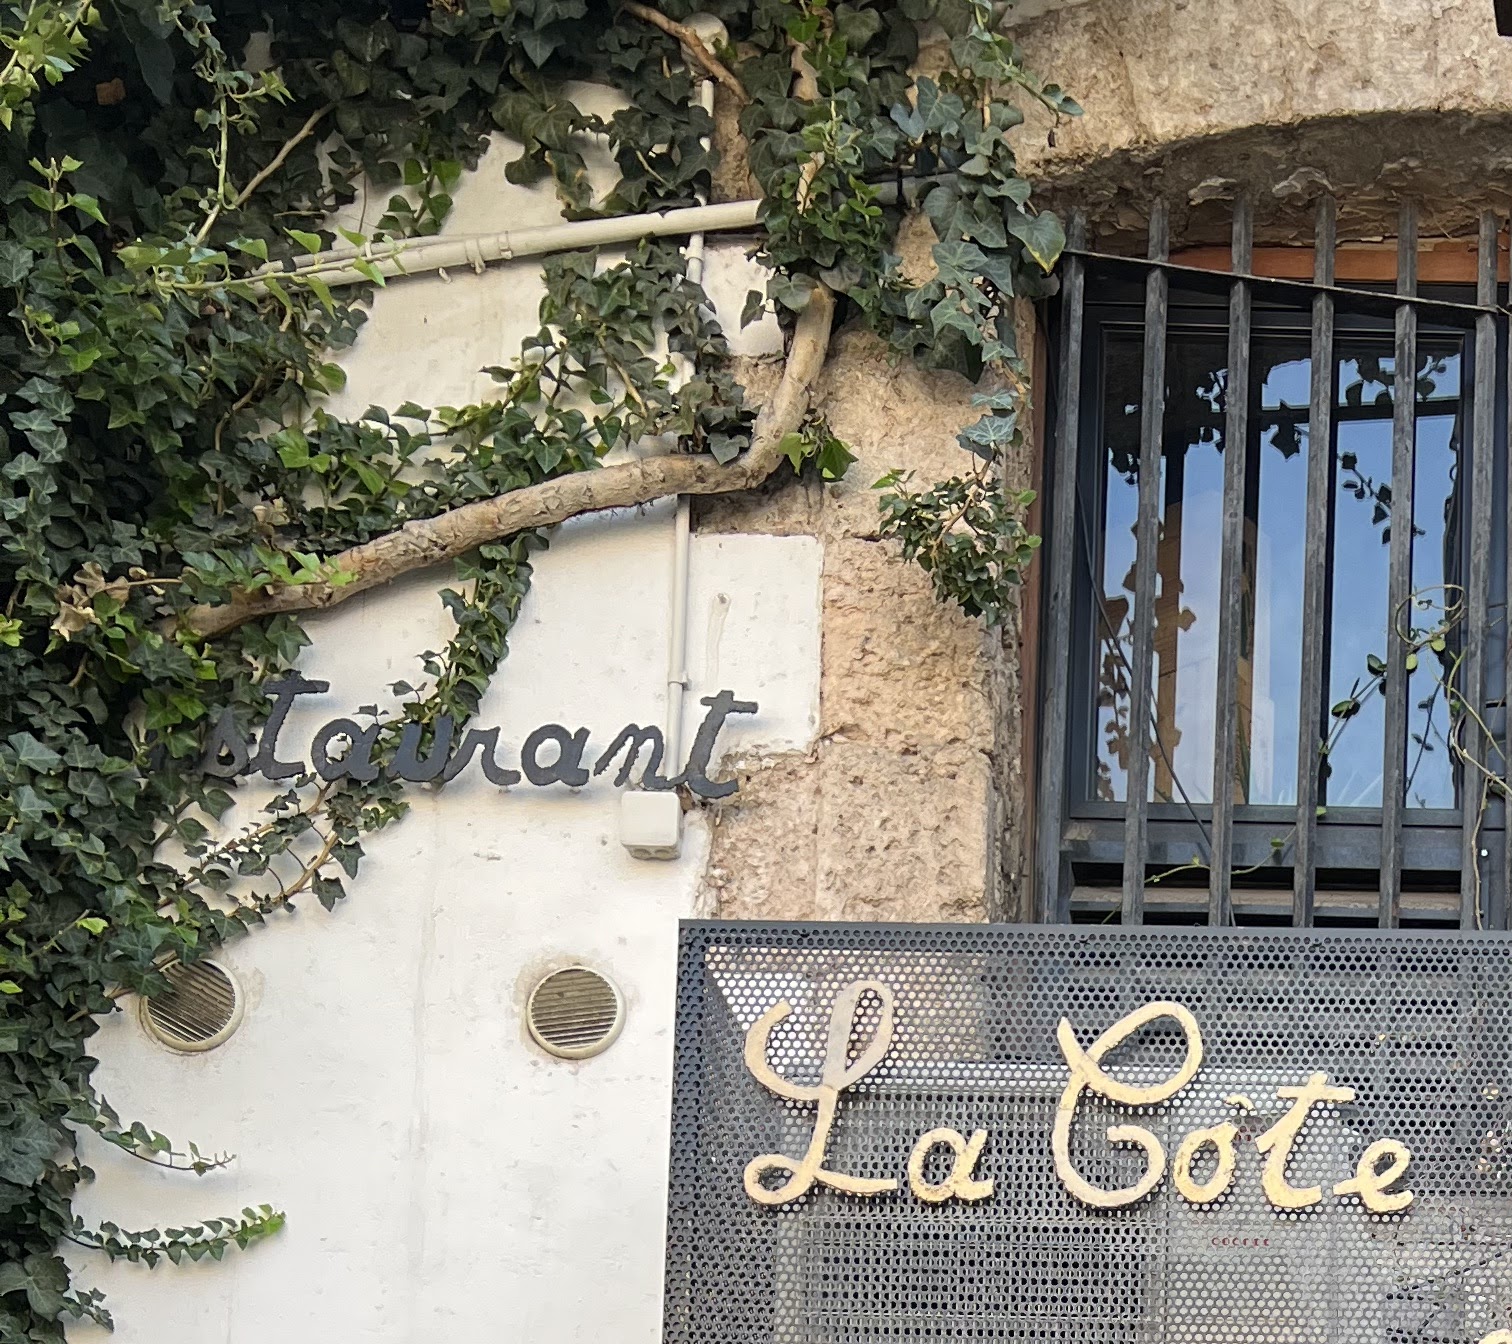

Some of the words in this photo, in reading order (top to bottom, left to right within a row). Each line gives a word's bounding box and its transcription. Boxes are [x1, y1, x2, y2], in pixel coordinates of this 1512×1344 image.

[198, 669, 759, 800] staurant
[743, 979, 995, 1205] La
[1052, 1000, 1415, 1213] Côte
